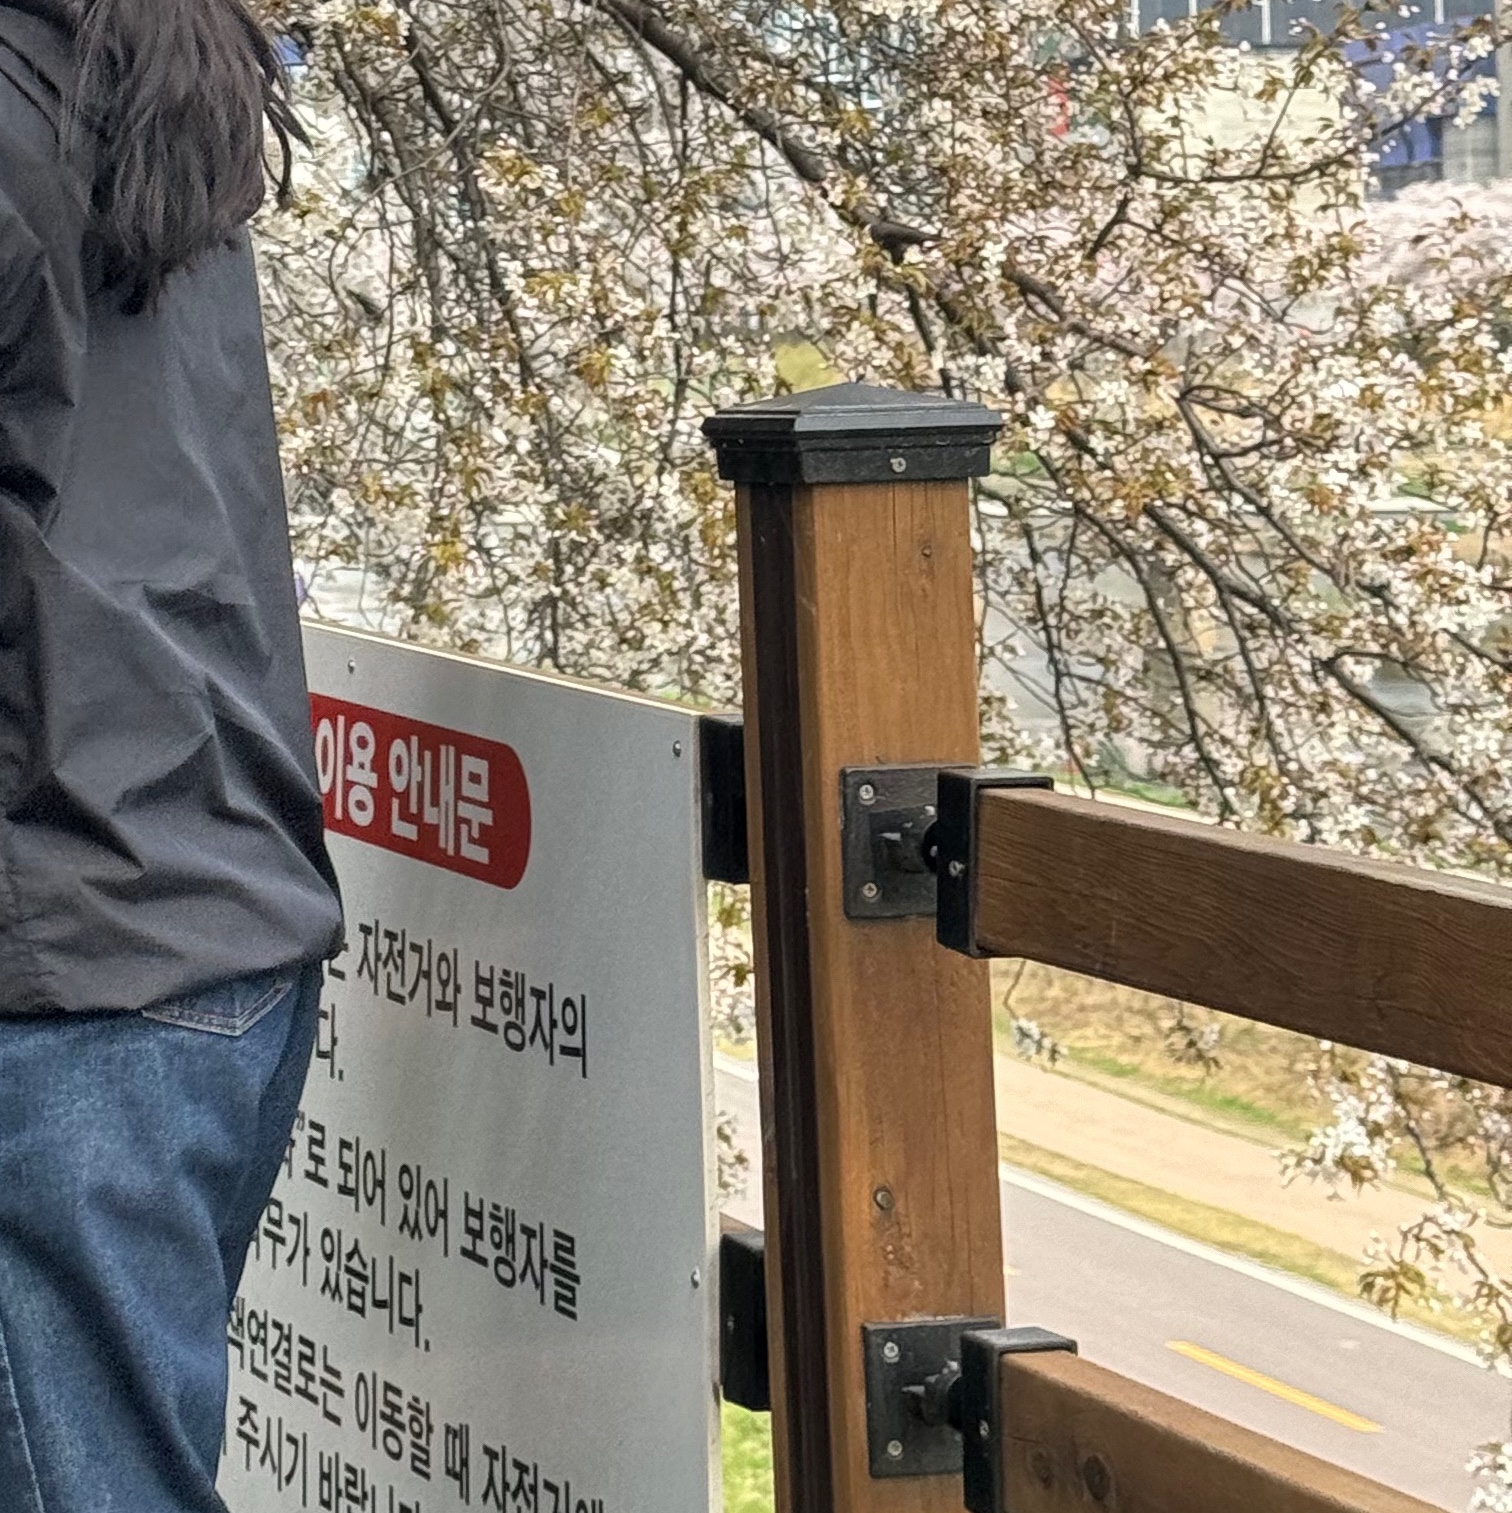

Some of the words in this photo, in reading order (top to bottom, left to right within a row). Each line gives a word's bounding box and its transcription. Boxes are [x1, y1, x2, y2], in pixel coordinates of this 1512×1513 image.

[315, 714, 377, 827] 이용
[389, 735, 493, 865] 안내문
[357, 919, 461, 1027] 자전거와
[471, 960, 587, 1079] 보행자의
[320, 1227, 430, 1353] 있습니다.
[337, 1136, 386, 1226] 되어
[398, 1163, 449, 1258] 있어
[460, 1191, 580, 1321] 보행자를
[236, 1395, 307, 1508] 주시기
[354, 1371, 434, 1482] 이동할
[444, 1422, 470, 1506] 때
